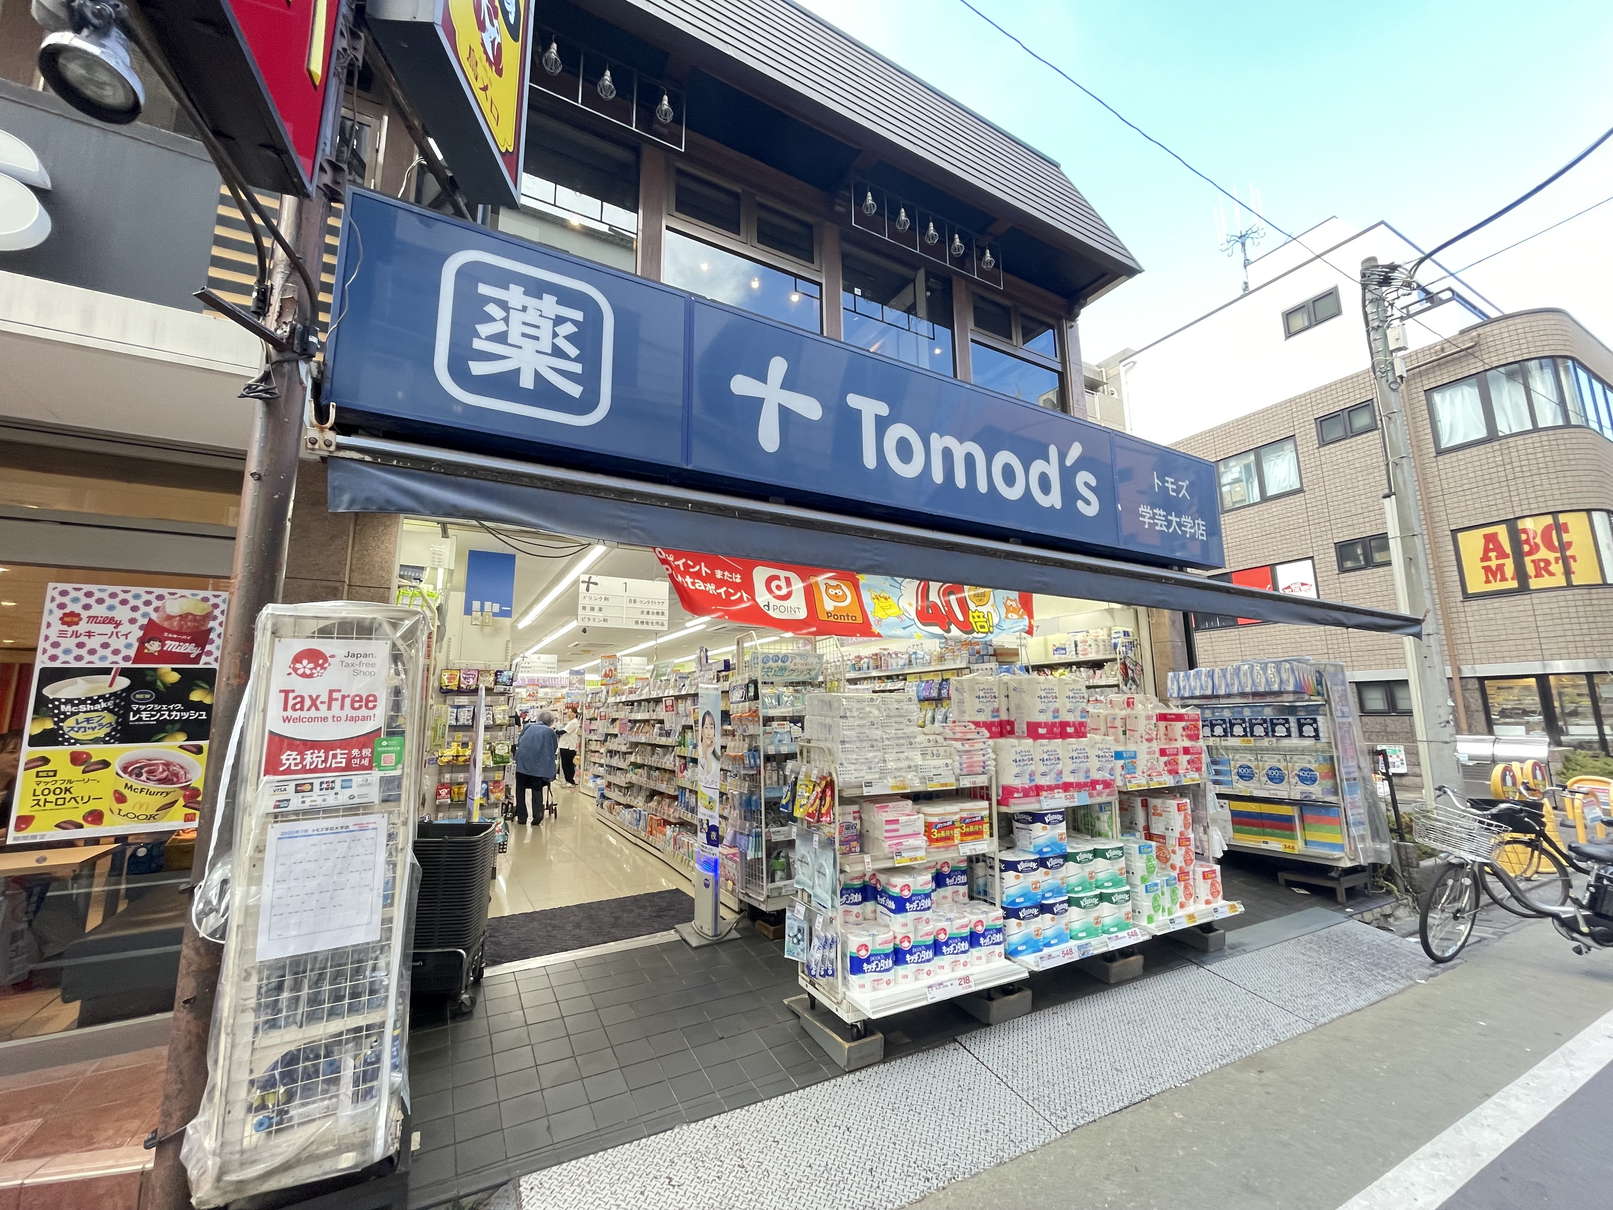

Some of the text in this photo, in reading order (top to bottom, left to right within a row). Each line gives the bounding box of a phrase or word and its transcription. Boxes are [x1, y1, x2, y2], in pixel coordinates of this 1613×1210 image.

[467, 283, 585, 399] 薬
[846, 393, 1100, 517] Tomod's
[1152, 470, 1191, 501] トモズ
[1138, 503, 1207, 541] 学芸大学店
[714, 568, 743, 584] または
[772, 604, 801, 615] POINT
[86, 615, 125, 629] Milky
[826, 611, 858, 622] Ponta
[163, 640, 204, 657] Milky
[339, 660, 376, 668] Tax-free
[352, 670, 376, 678] Shop
[60, 700, 115, 713] McShake
[278, 689, 378, 713] Tax-Free
[75, 715, 106, 726] レモン
[129, 711, 208, 721] レモンスカッシュ
[281, 713, 376, 724] Welcome to Japan!
[66, 722, 115, 735] スカッシュ
[279, 749, 348, 771] 免税店
[32, 786, 73, 798] LOOK
[123, 782, 171, 798] McFlurry
[31, 796, 103, 808] ストロベリー
[117, 808, 159, 821] LOOK
[1017, 860, 1040, 871] Kleenex
[905, 895, 932, 912] キッチンタオル
[1080, 897, 1100, 907] Kleenex
[1019, 908, 1040, 919] Kleenex
[905, 949, 934, 964] キッチンタオル
[862, 958, 893, 973] キッチンタオル
[957, 975, 971, 986] 218
